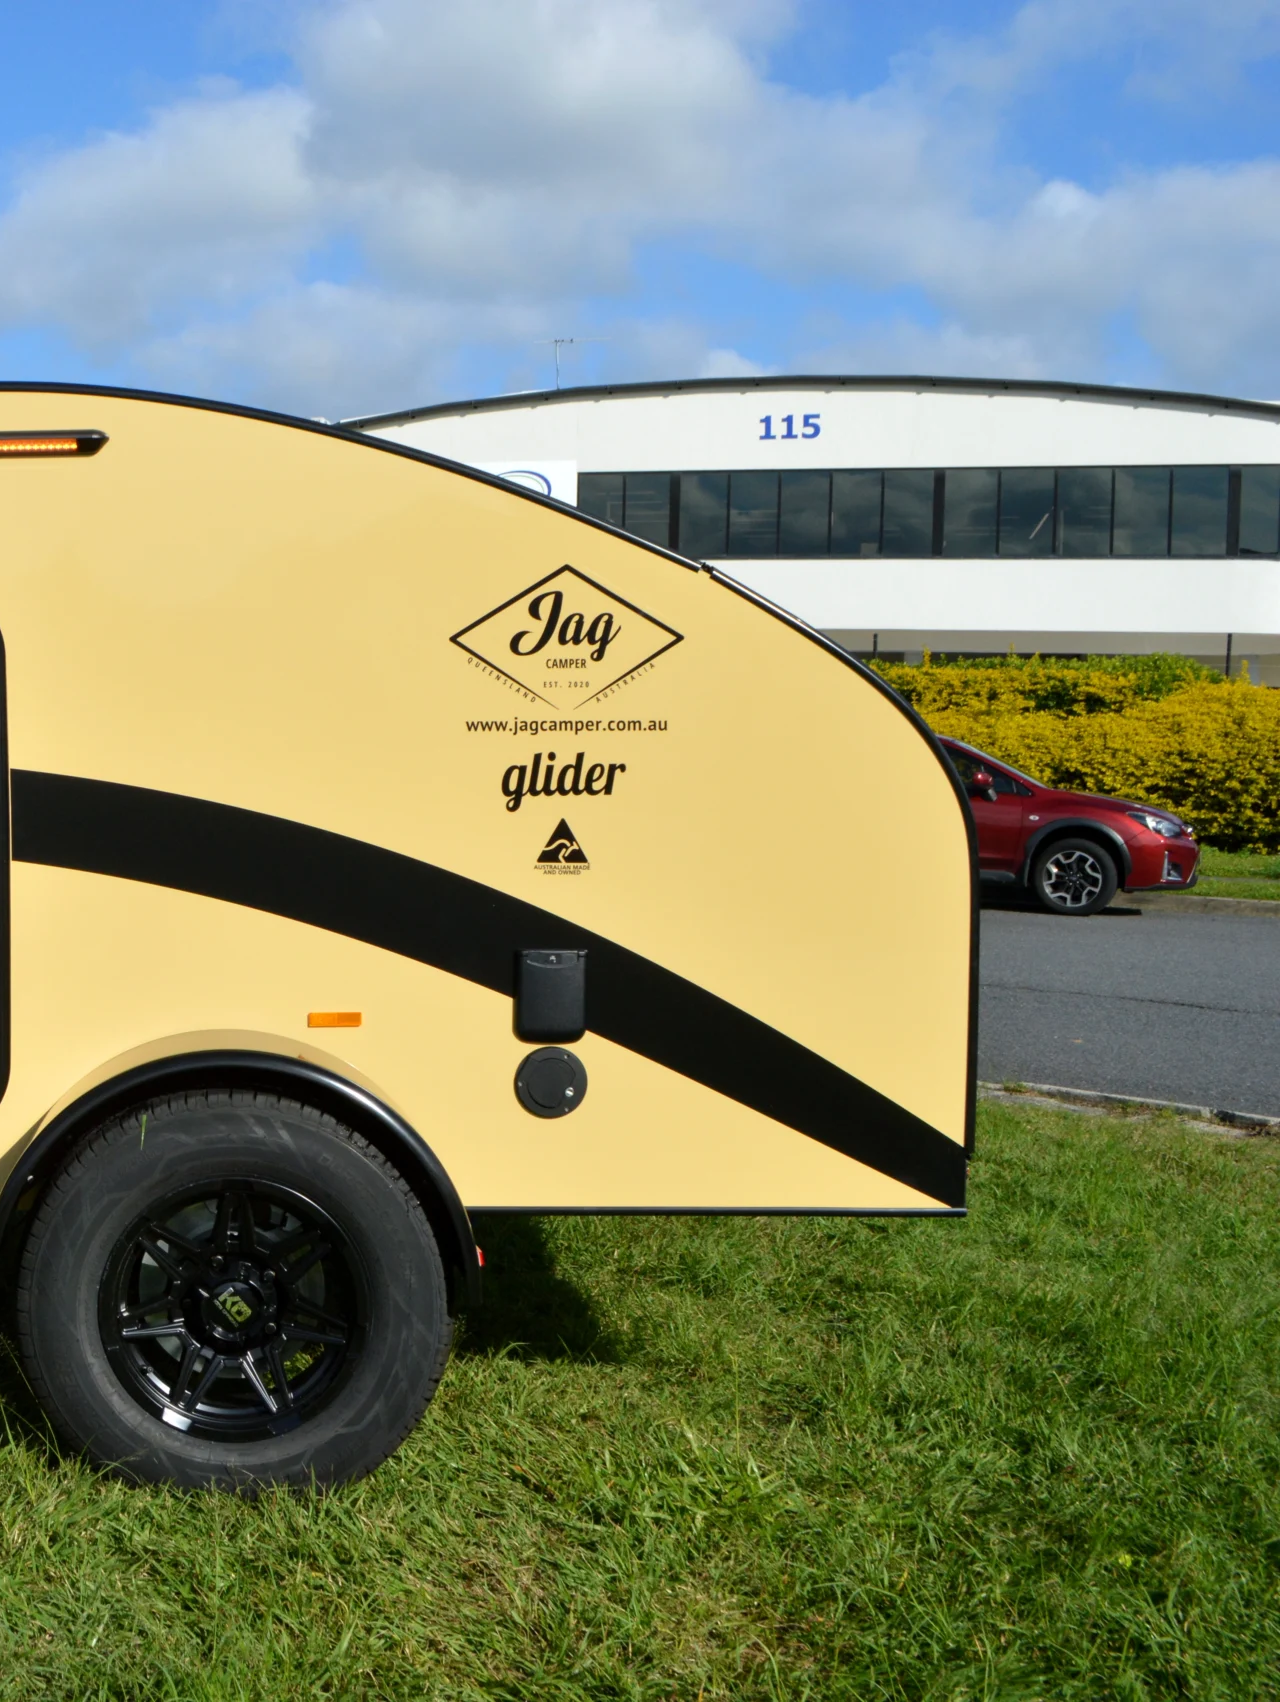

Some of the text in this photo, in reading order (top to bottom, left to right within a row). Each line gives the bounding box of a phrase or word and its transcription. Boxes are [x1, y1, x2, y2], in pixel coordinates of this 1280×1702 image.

[758, 413, 822, 440] 115
[509, 590, 622, 662] Jag
[467, 656, 537, 703] QUEENSLAND
[545, 658, 587, 669] CAMPER
[543, 681, 590, 689] EST. 2020
[595, 662, 656, 704] AUSTRALIA
[465, 716, 669, 736] www.jagcamper.com.au
[501, 751, 627, 813] glider
